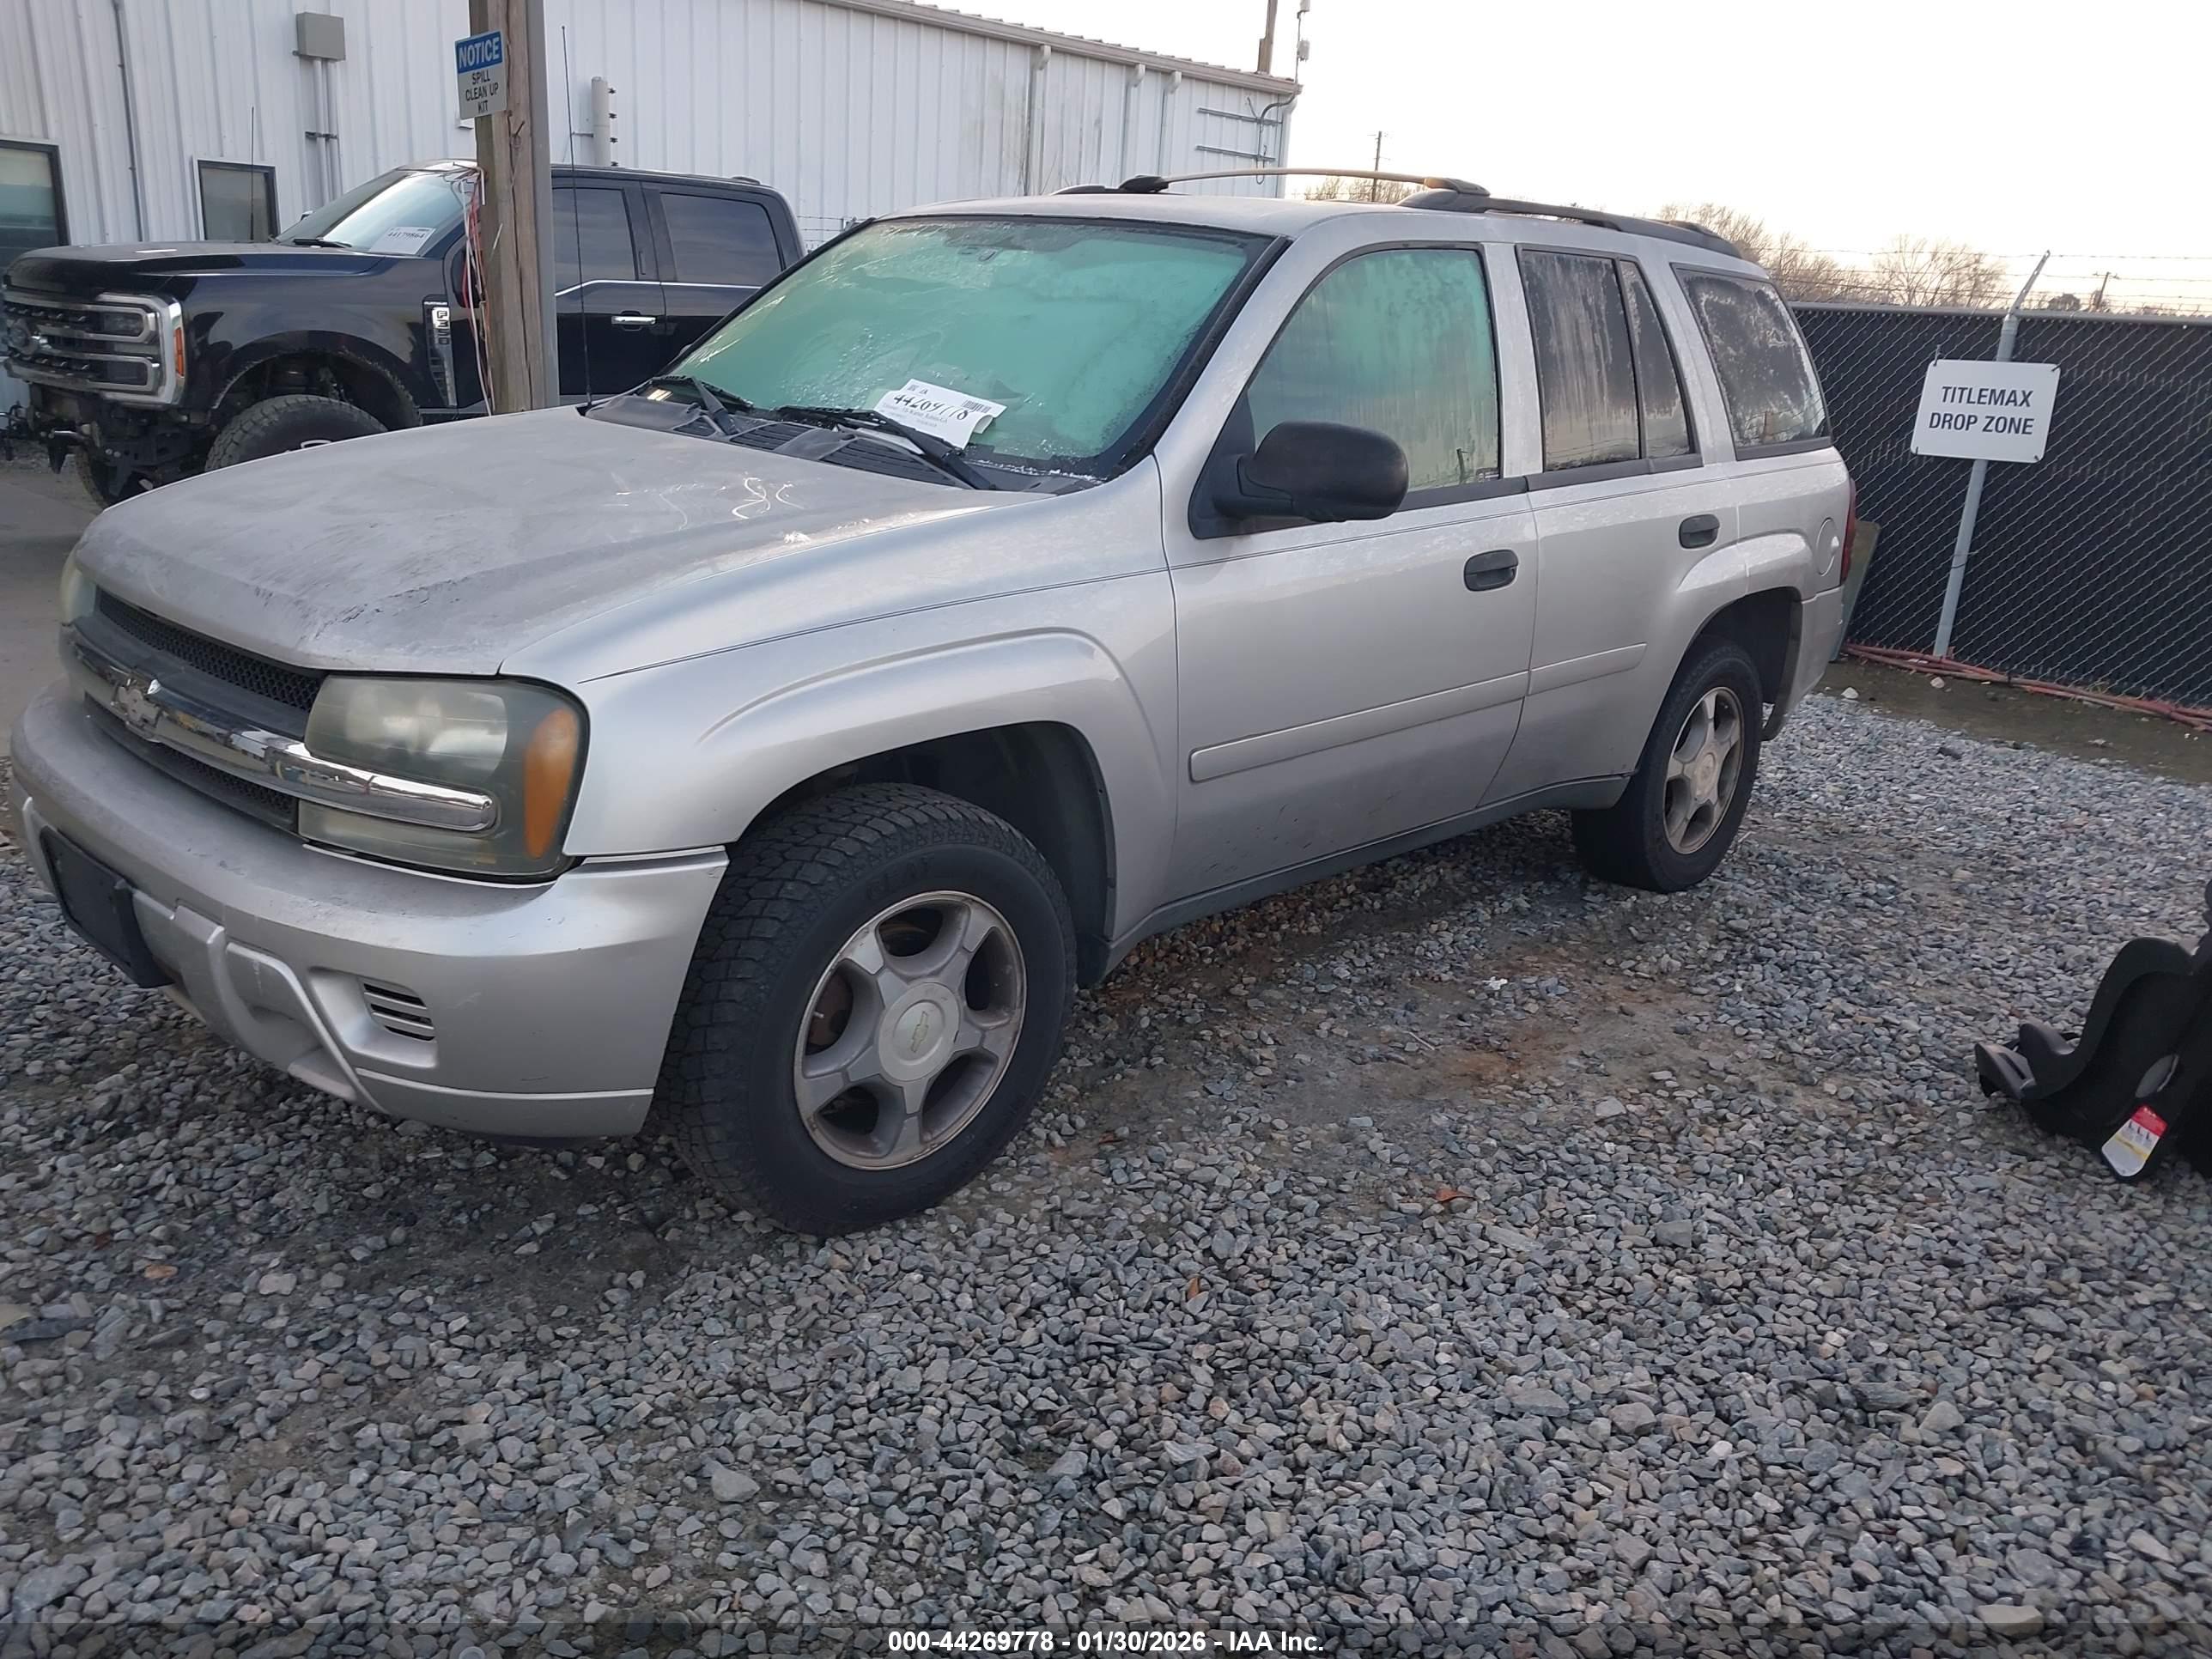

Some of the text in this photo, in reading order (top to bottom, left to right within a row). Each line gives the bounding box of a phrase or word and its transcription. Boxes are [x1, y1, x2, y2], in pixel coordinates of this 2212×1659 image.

[459, 37, 500, 69] NOTICE
[471, 70, 490, 85] SPILL
[465, 82, 499, 101] CLEAN UP
[477, 100, 489, 112] KIT
[1942, 386, 2033, 407] TITLEMAX
[1929, 412, 2034, 434] DROP ZONE
